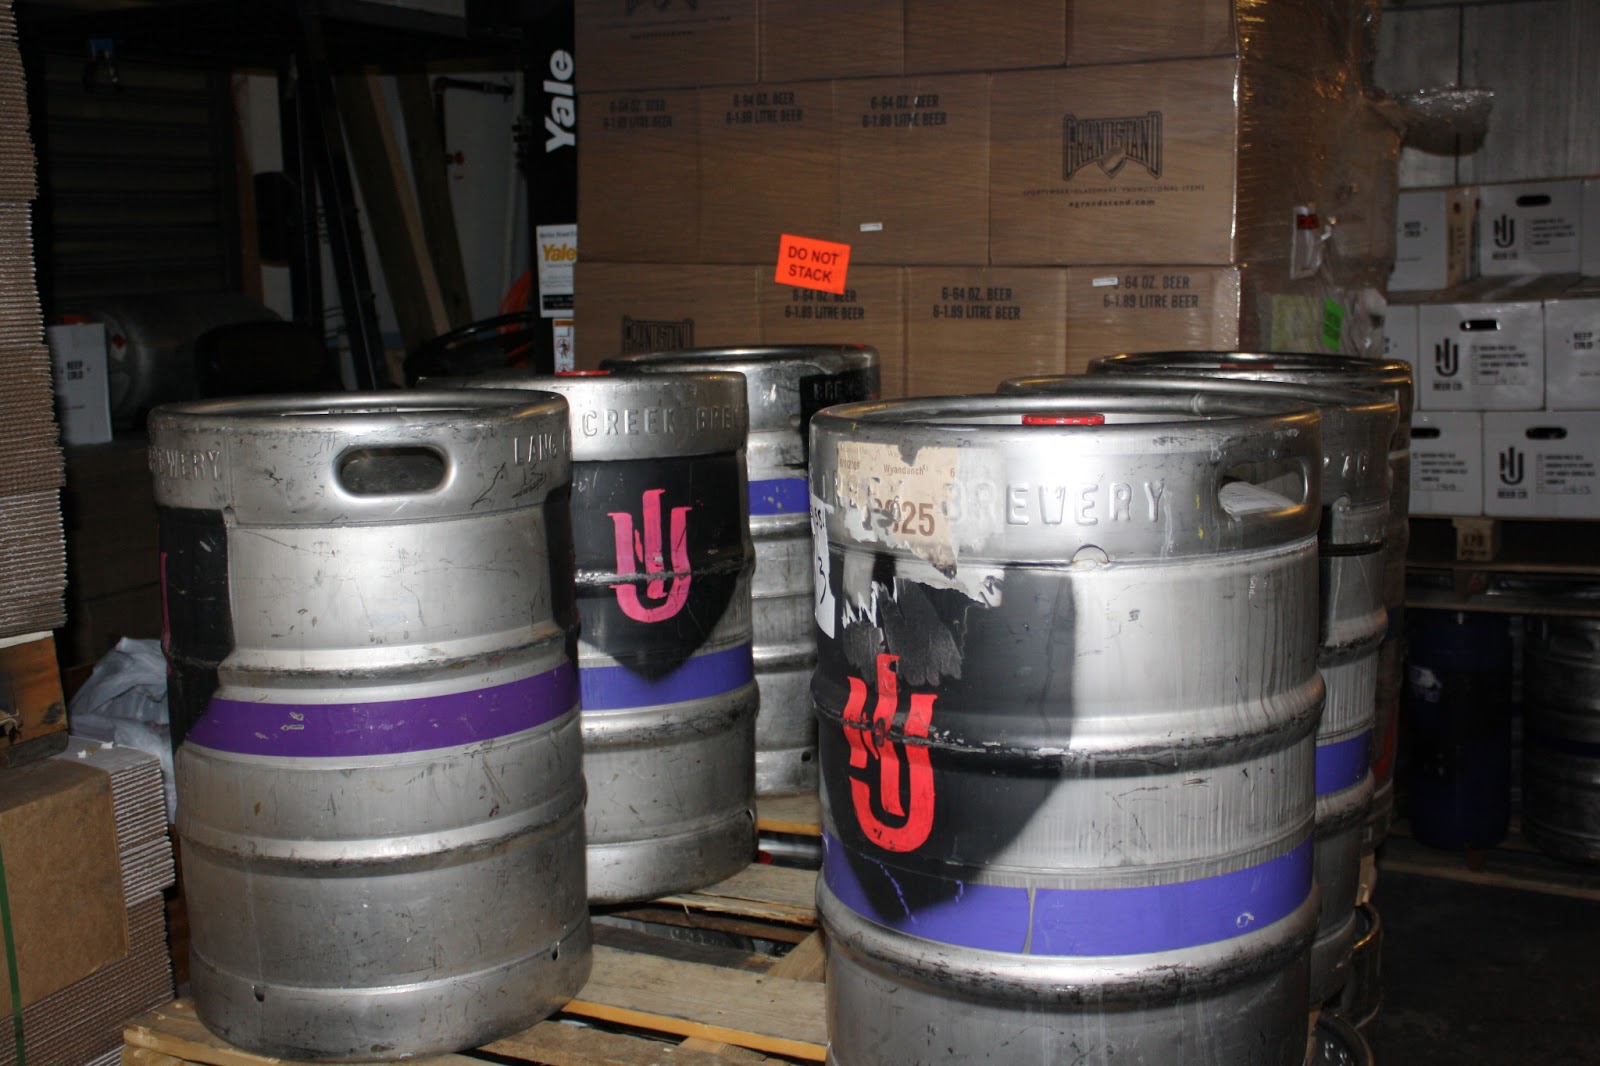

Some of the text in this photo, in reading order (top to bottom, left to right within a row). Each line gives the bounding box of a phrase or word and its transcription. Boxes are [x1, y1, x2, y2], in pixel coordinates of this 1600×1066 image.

[543, 50, 576, 153] Yale
[923, 112, 947, 126] BEER
[542, 244, 577, 262] Yale
[788, 246, 839, 266] DO NOT
[788, 264, 832, 284] STACK
[1163, 276, 1190, 289] BEER
[942, 287, 964, 301] 6-64
[987, 287, 1012, 301] BEER
[1139, 295, 1168, 309] LITRE
[1171, 295, 1199, 308] BEER
[841, 307, 865, 320] BEER
[966, 305, 992, 320] LITRE
[995, 306, 1021, 320] BEER
[582, 407, 677, 437] CREEK
[514, 433, 557, 465] LANG
[883, 464, 924, 476] Wyandanch
